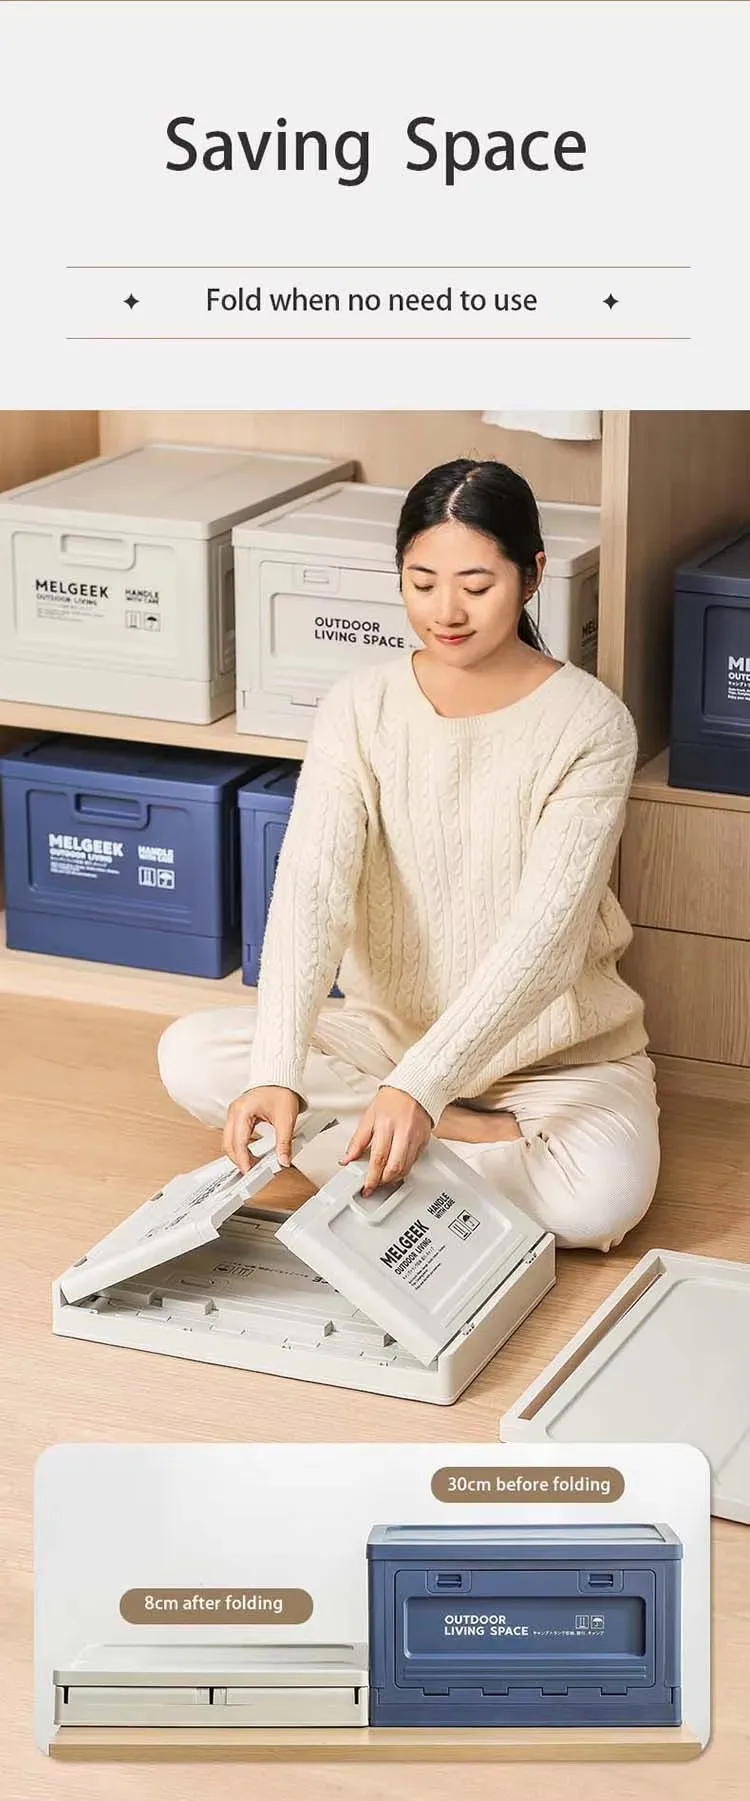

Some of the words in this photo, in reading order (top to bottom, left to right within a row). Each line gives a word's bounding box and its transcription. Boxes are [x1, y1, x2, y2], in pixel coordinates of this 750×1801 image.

[36, 580, 108, 598] MELGEEK
[315, 617, 380, 632] OUTDOOR
[314, 629, 357, 643] LIVING
[363, 634, 404, 648] SPACE
[49, 834, 123, 857] MELGEEK
[427, 1192, 450, 1216] HANDLE
[380, 1219, 429, 1268] MELGEEK
[394, 1251, 418, 1275] OUTDOOR
[414, 1237, 432, 1254] LIVING
[444, 1615, 506, 1625] OUTDOOR
[444, 1626, 484, 1636] LIVING
[490, 1626, 529, 1636] SPACE
